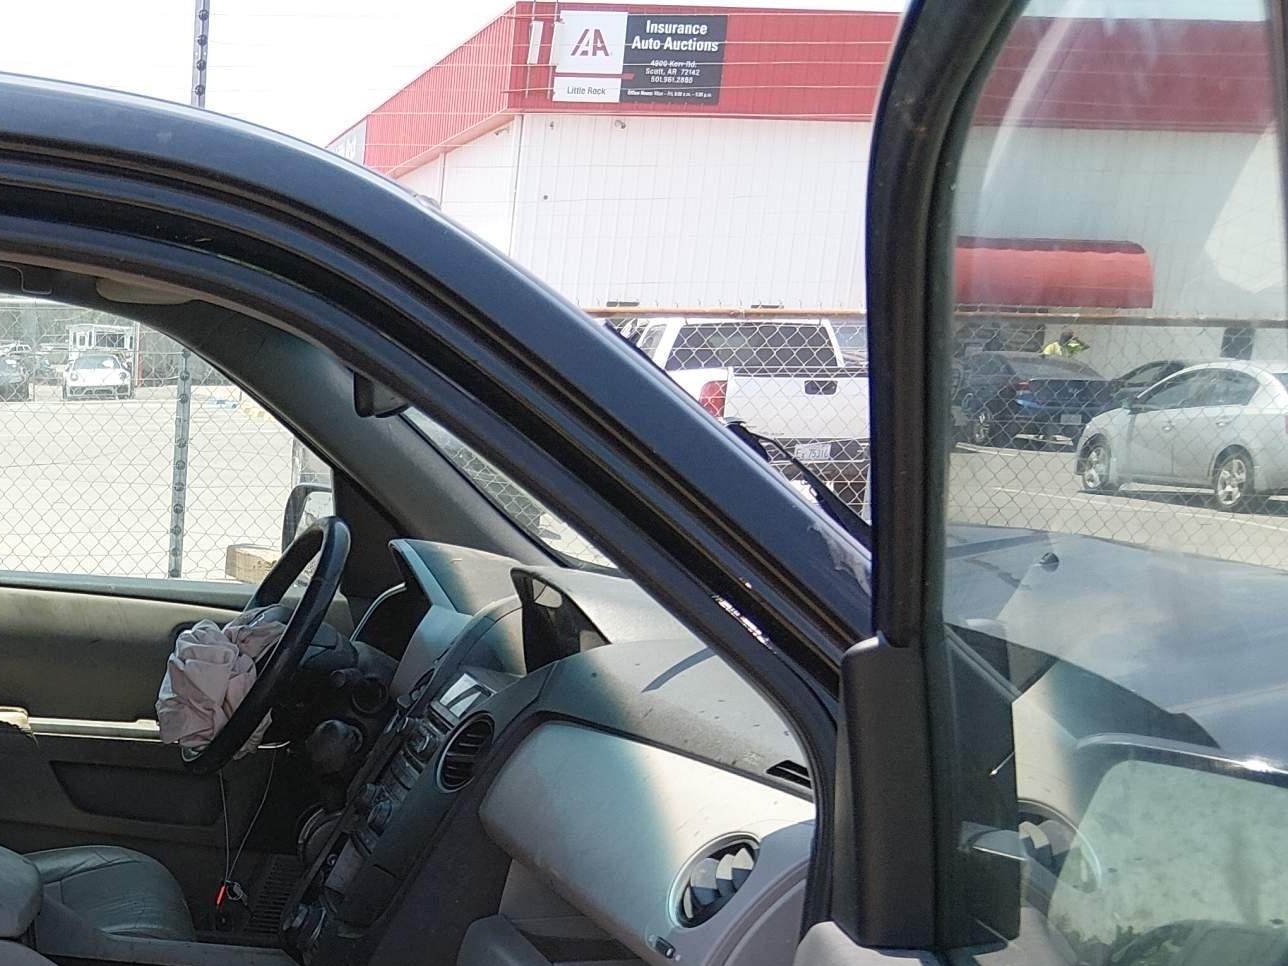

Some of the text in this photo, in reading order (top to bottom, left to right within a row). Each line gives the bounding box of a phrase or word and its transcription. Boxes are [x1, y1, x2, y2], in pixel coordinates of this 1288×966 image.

[646, 19, 708, 35] Insurance
[631, 35, 719, 52] Auto Auctions
[567, 86, 606, 95] Little Rock
